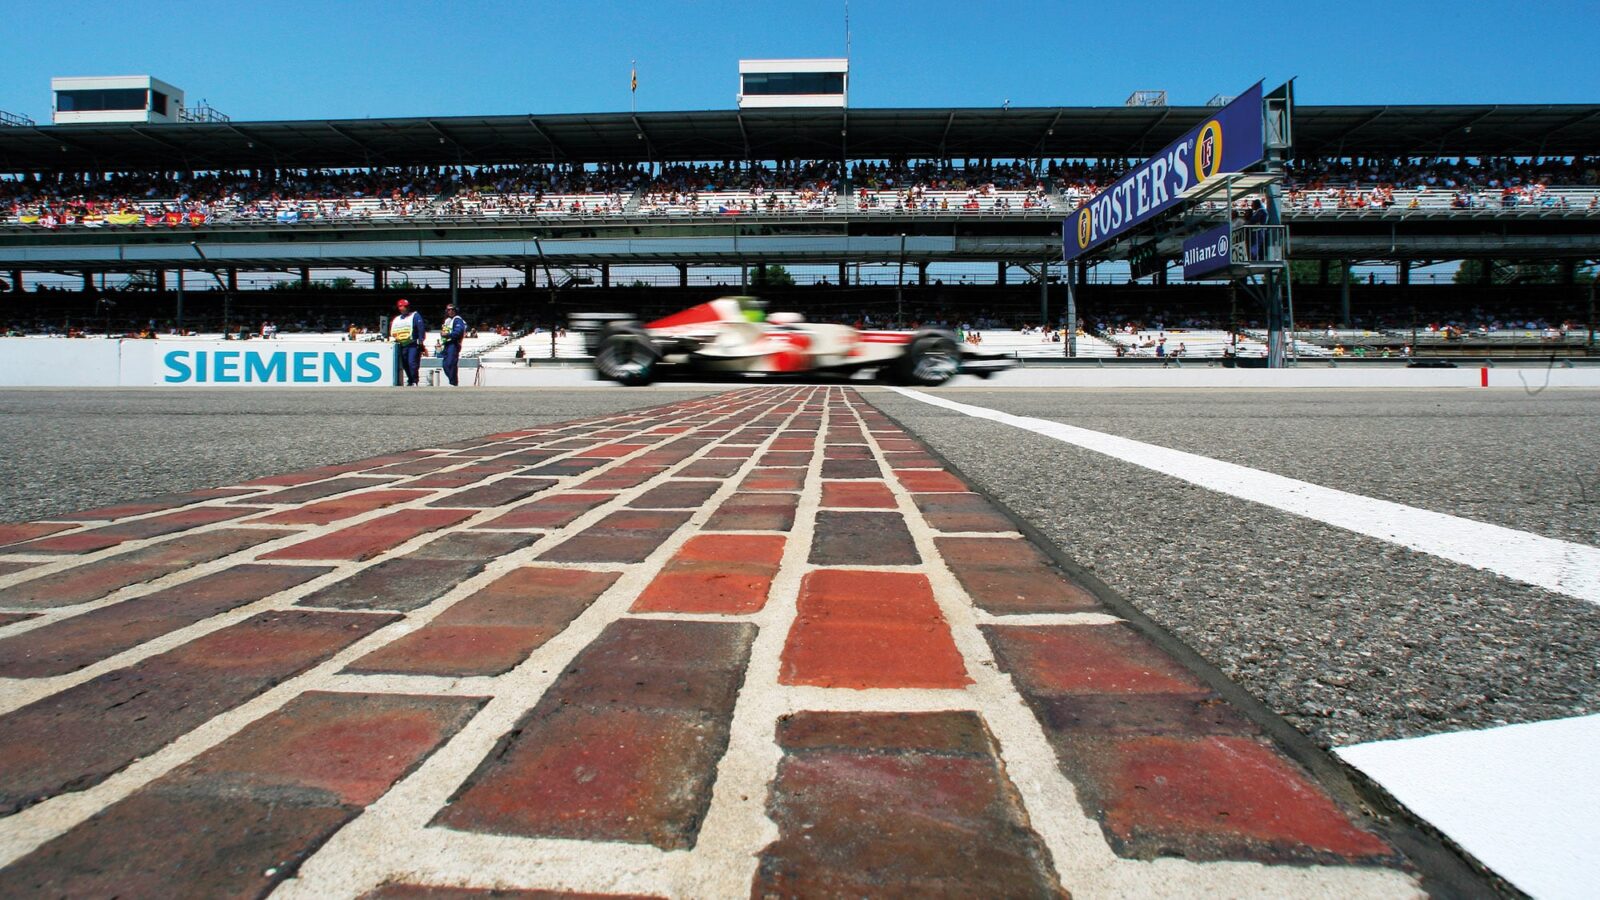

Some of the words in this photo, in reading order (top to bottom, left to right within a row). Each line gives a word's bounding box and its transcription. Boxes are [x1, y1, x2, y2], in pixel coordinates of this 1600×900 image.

[1202, 136, 1213, 168] F
[1184, 244, 1216, 267] Allianz
[164, 350, 382, 383] SIEMENS
